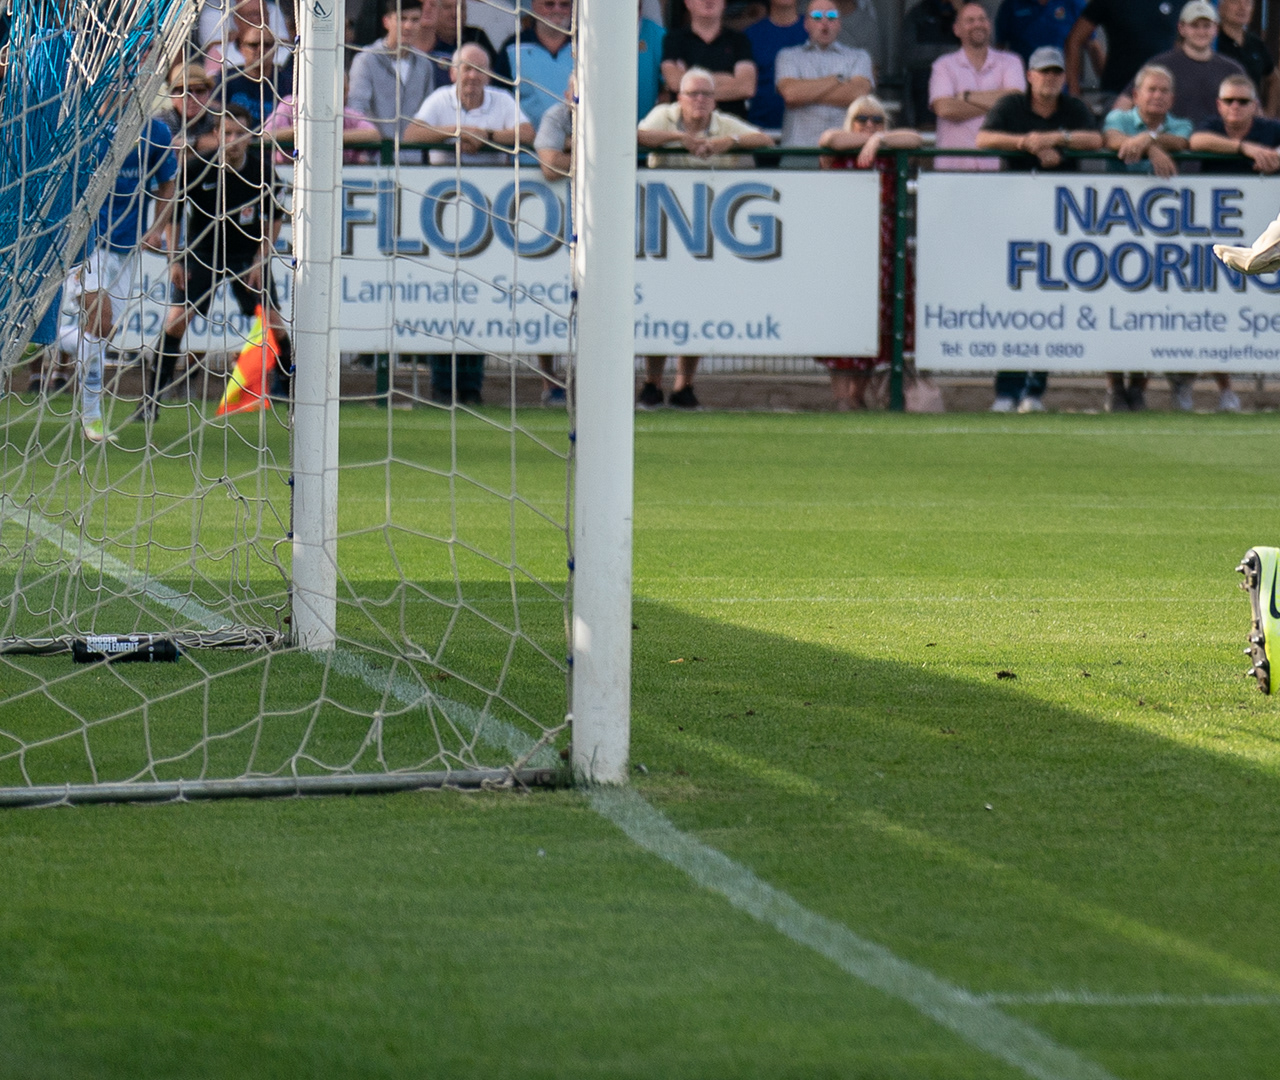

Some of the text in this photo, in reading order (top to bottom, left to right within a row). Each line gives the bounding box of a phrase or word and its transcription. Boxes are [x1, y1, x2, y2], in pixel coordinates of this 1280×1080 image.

[341, 178, 782, 262] FLOOING
[1054, 186, 1243, 237] NAGLE
[923, 304, 1065, 331] Hardwood
[1076, 307, 1097, 332] &
[1109, 305, 1227, 333] Laminate
[941, 341, 963, 357] Tel:
[969, 342, 997, 358] 020
[1002, 342, 1039, 358] 8424
[1045, 343, 1084, 359] 0800
[86, 642, 139, 653] SUPPLEMENT
